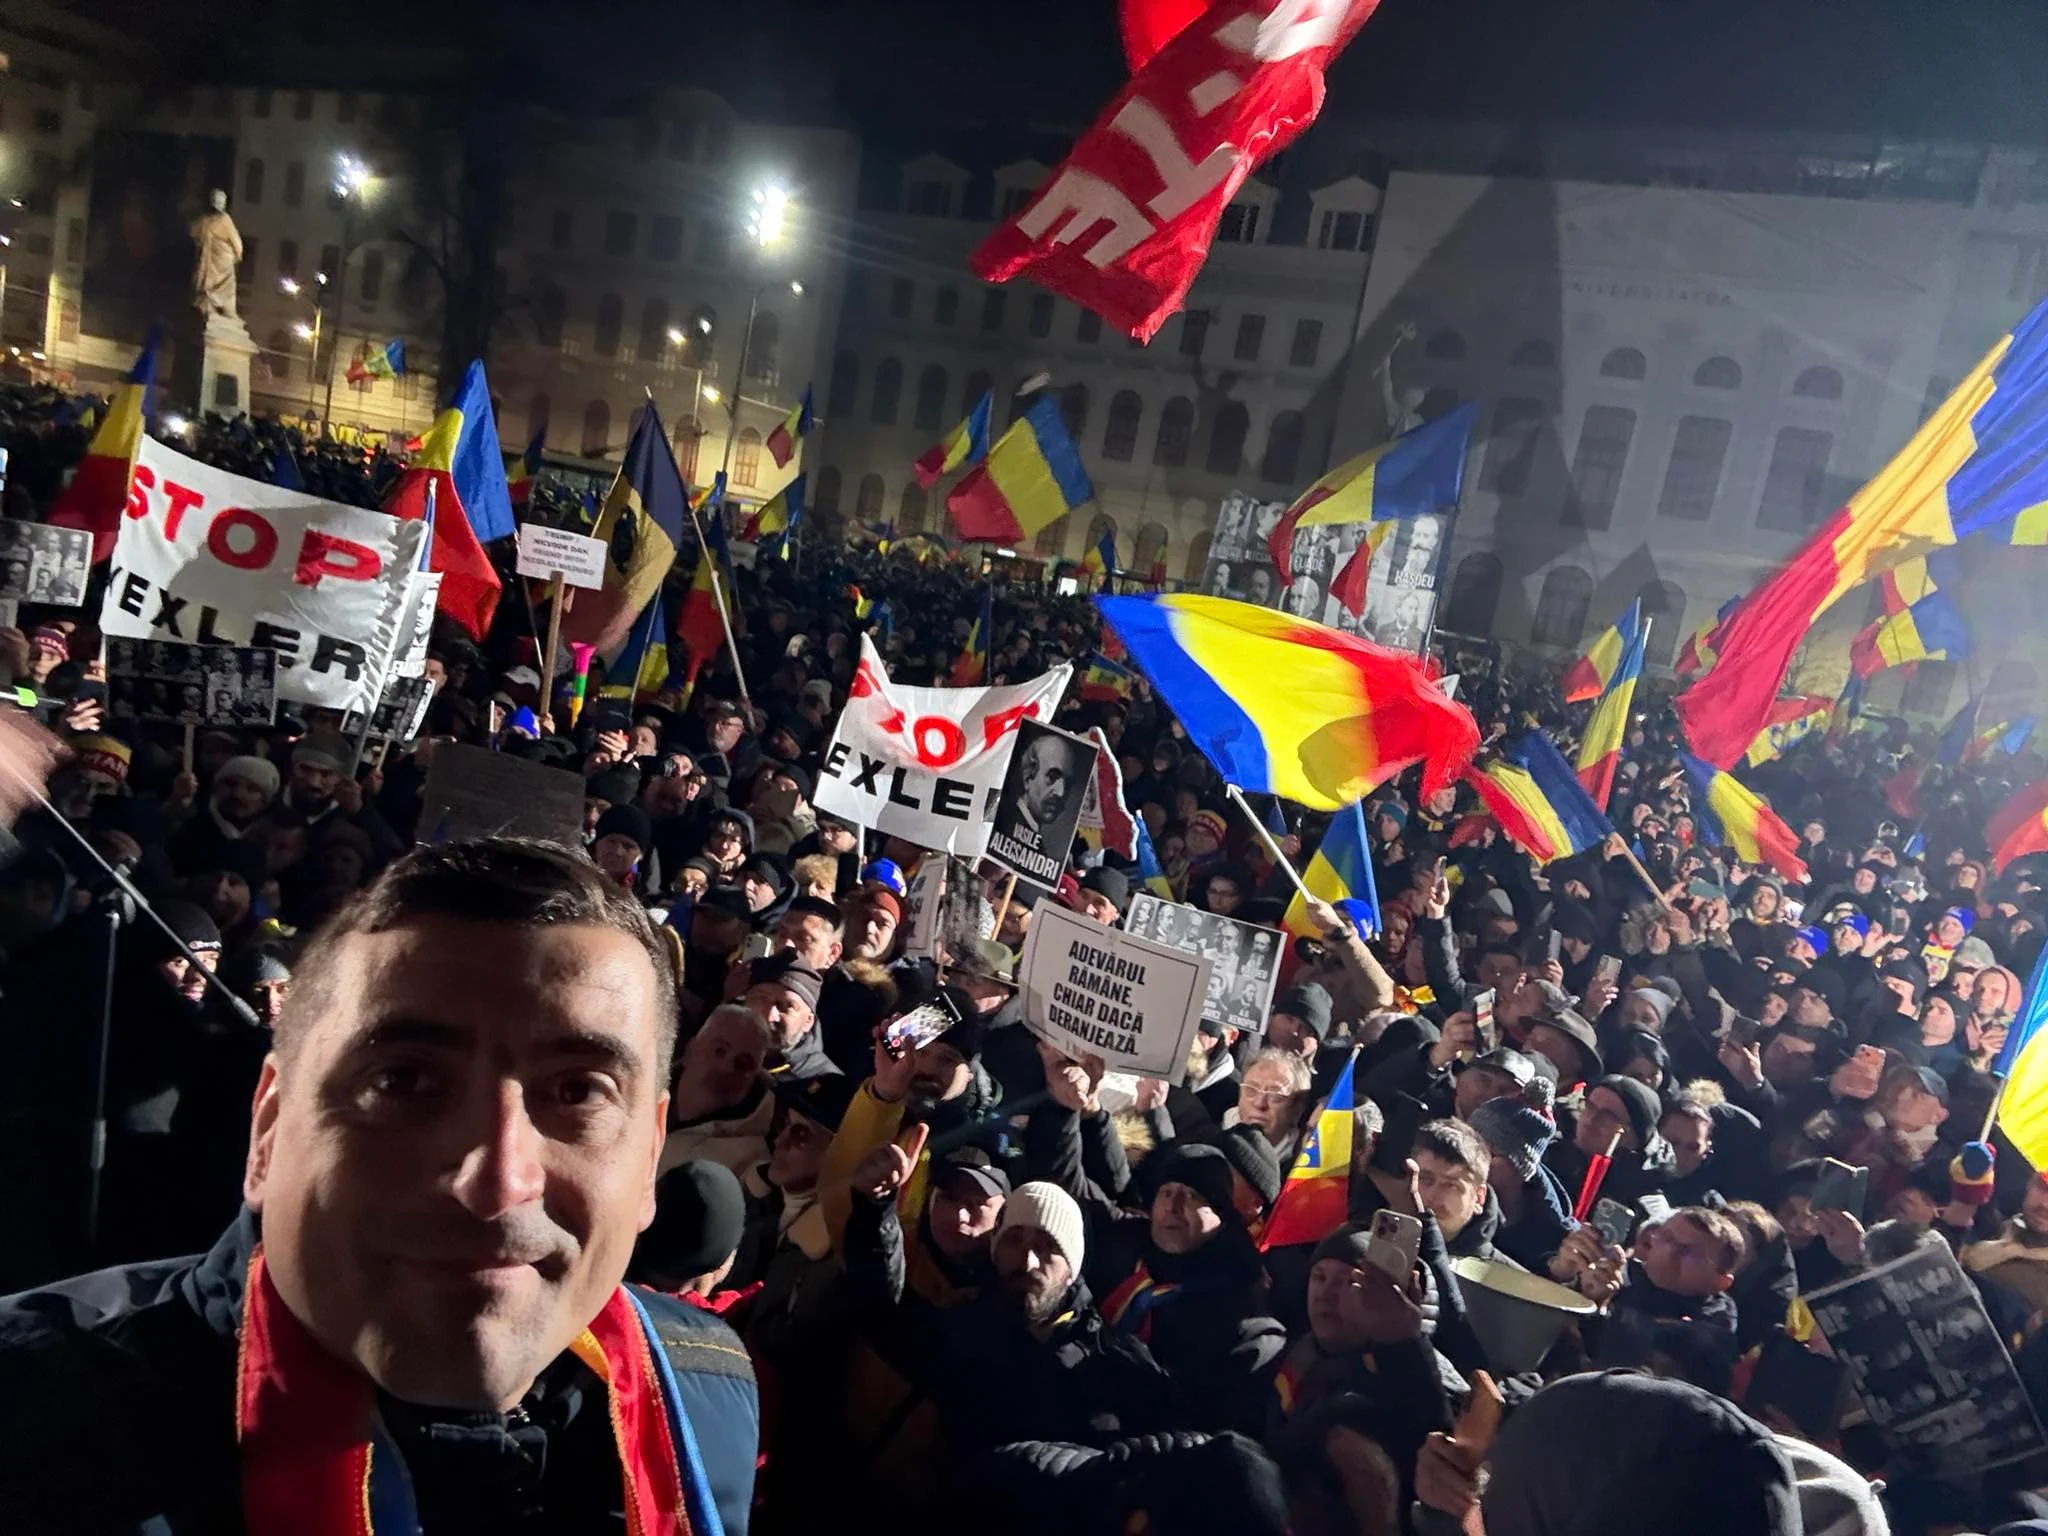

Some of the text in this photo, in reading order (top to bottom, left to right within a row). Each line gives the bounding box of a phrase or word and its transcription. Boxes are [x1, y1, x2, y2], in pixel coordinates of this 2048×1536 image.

[125, 464, 384, 589] STOP
[822, 741, 1001, 822] EXLE
[989, 829, 1060, 880] ALECSANDRI
[1013, 821, 1042, 850] VASILE
[1068, 940, 1146, 985] ADEVĂRUL
[1048, 1003, 1140, 1056] DERANJEAZĂ.
[1053, 981, 1144, 1034] CHIAR DACĂ
